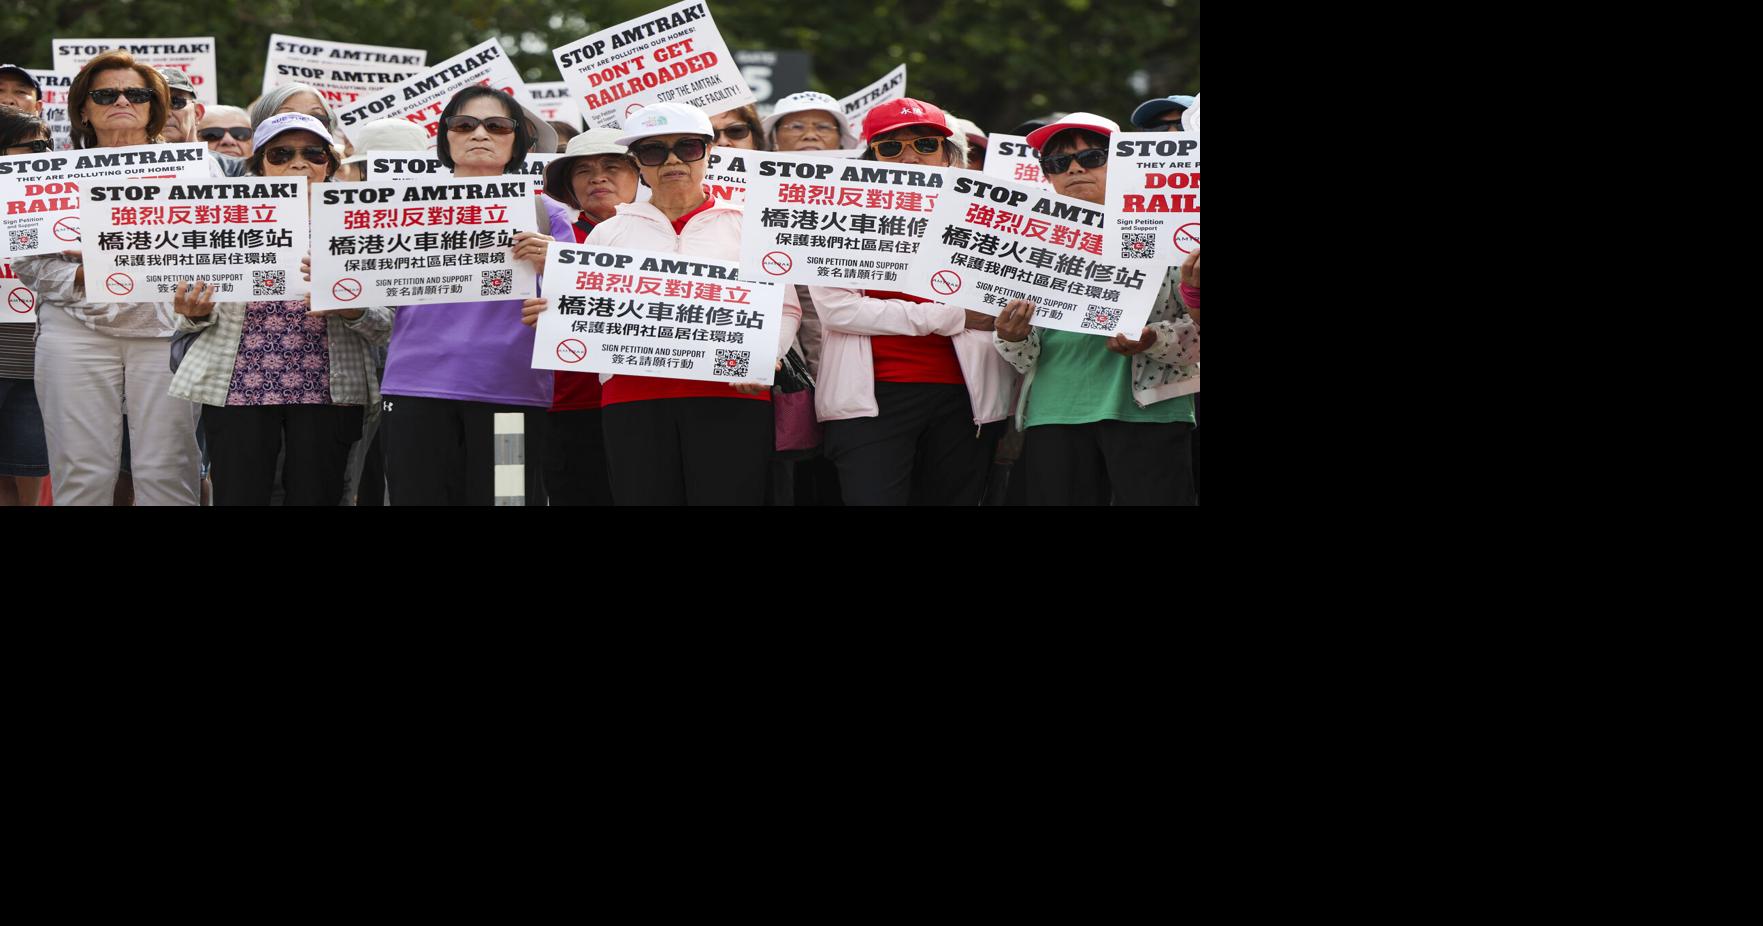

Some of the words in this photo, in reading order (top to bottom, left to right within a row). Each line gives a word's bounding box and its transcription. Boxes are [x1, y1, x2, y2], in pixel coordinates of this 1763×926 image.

[560, 40, 605, 68] STOP
[611, 3, 706, 50] AMTRAK!
[59, 45, 108, 56] STOP
[276, 42, 323, 55] STOP
[329, 49, 420, 65] AMTRAK!
[578, 64, 595, 74] THEY
[597, 58, 610, 67] ARE
[611, 44, 650, 62] POLLUTING
[650, 37, 667, 48] OUR
[668, 27, 695, 42] HOMES!
[277, 64, 325, 79] STOP
[587, 55, 645, 87] DON'T
[653, 38, 694, 63] GET
[340, 94, 396, 126] STOP
[402, 46, 500, 101] AMTRAK!
[584, 51, 718, 111] RAILROADED
[657, 90, 676, 103] STOP
[677, 84, 693, 97] THE
[691, 74, 723, 93] AMTRAK
[388, 110, 401, 119] ARE
[404, 90, 446, 112] POLLUTING
[447, 82, 463, 92] OUR
[706, 84, 741, 105] FACILITY!
[842, 73, 903, 114] MTRAK!
[1116, 140, 1198, 157] STOP
[0, 158, 67, 174] STOP
[75, 149, 203, 169] AMTRAK!
[67, 170, 122, 179] POLLUTING
[148, 165, 185, 173] HOMES!
[374, 159, 442, 173] STOP
[759, 161, 833, 180] STOP
[90, 185, 161, 201] STOP
[168, 183, 298, 200] AMTRAK!
[323, 187, 395, 204] STOP
[402, 182, 526, 202] AMTRAK!
[953, 177, 1028, 207] STOP
[1031, 199, 1104, 228] AMT
[7, 197, 80, 215] RAIL
[111, 203, 277, 226] 強烈反對建立
[344, 204, 508, 230] 強烈反對建立
[98, 228, 293, 251] 橋港火車維修站
[329, 229, 524, 256] 橋港火車維修站
[114, 252, 277, 267] 保護我們社區居住環境
[344, 251, 505, 272] 保護我們社區居住環境
[558, 249, 633, 269] STOP
[640, 258, 757, 283] AMTRA
[807, 256, 823, 265] SIGN
[825, 257, 857, 267] PETITION
[859, 260, 875, 269] AND
[876, 261, 908, 271] SUPPORT
[941, 224, 1147, 290] 橋港火車維修站
[163, 274, 194, 282] PETITION
[212, 273, 243, 281] SUPPORT
[375, 279, 391, 287] SIGN
[393, 277, 425, 286] PETITION
[442, 275, 473, 283] SUPPORT
[817, 266, 897, 282] 簽名請願行動
[950, 252, 1121, 302] 保護我們社區居住環境
[386, 285, 463, 297] 簽名請願行動
[575, 271, 751, 304] 強烈反對建立
[976, 281, 993, 291] SIGN
[994, 286, 1026, 300] PETITION
[1027, 294, 1042, 304] AND
[1043, 297, 1078, 311] SUPPORT
[558, 294, 765, 330] 橋港火車維修站
[571, 320, 744, 344] 保護我們社區居住環境
[602, 344, 618, 352] SIGN
[619, 344, 654, 355] PETITION
[655, 347, 671, 356] AND
[672, 348, 705, 359] SUPPORT
[612, 353, 694, 369] 簽名請願行動
